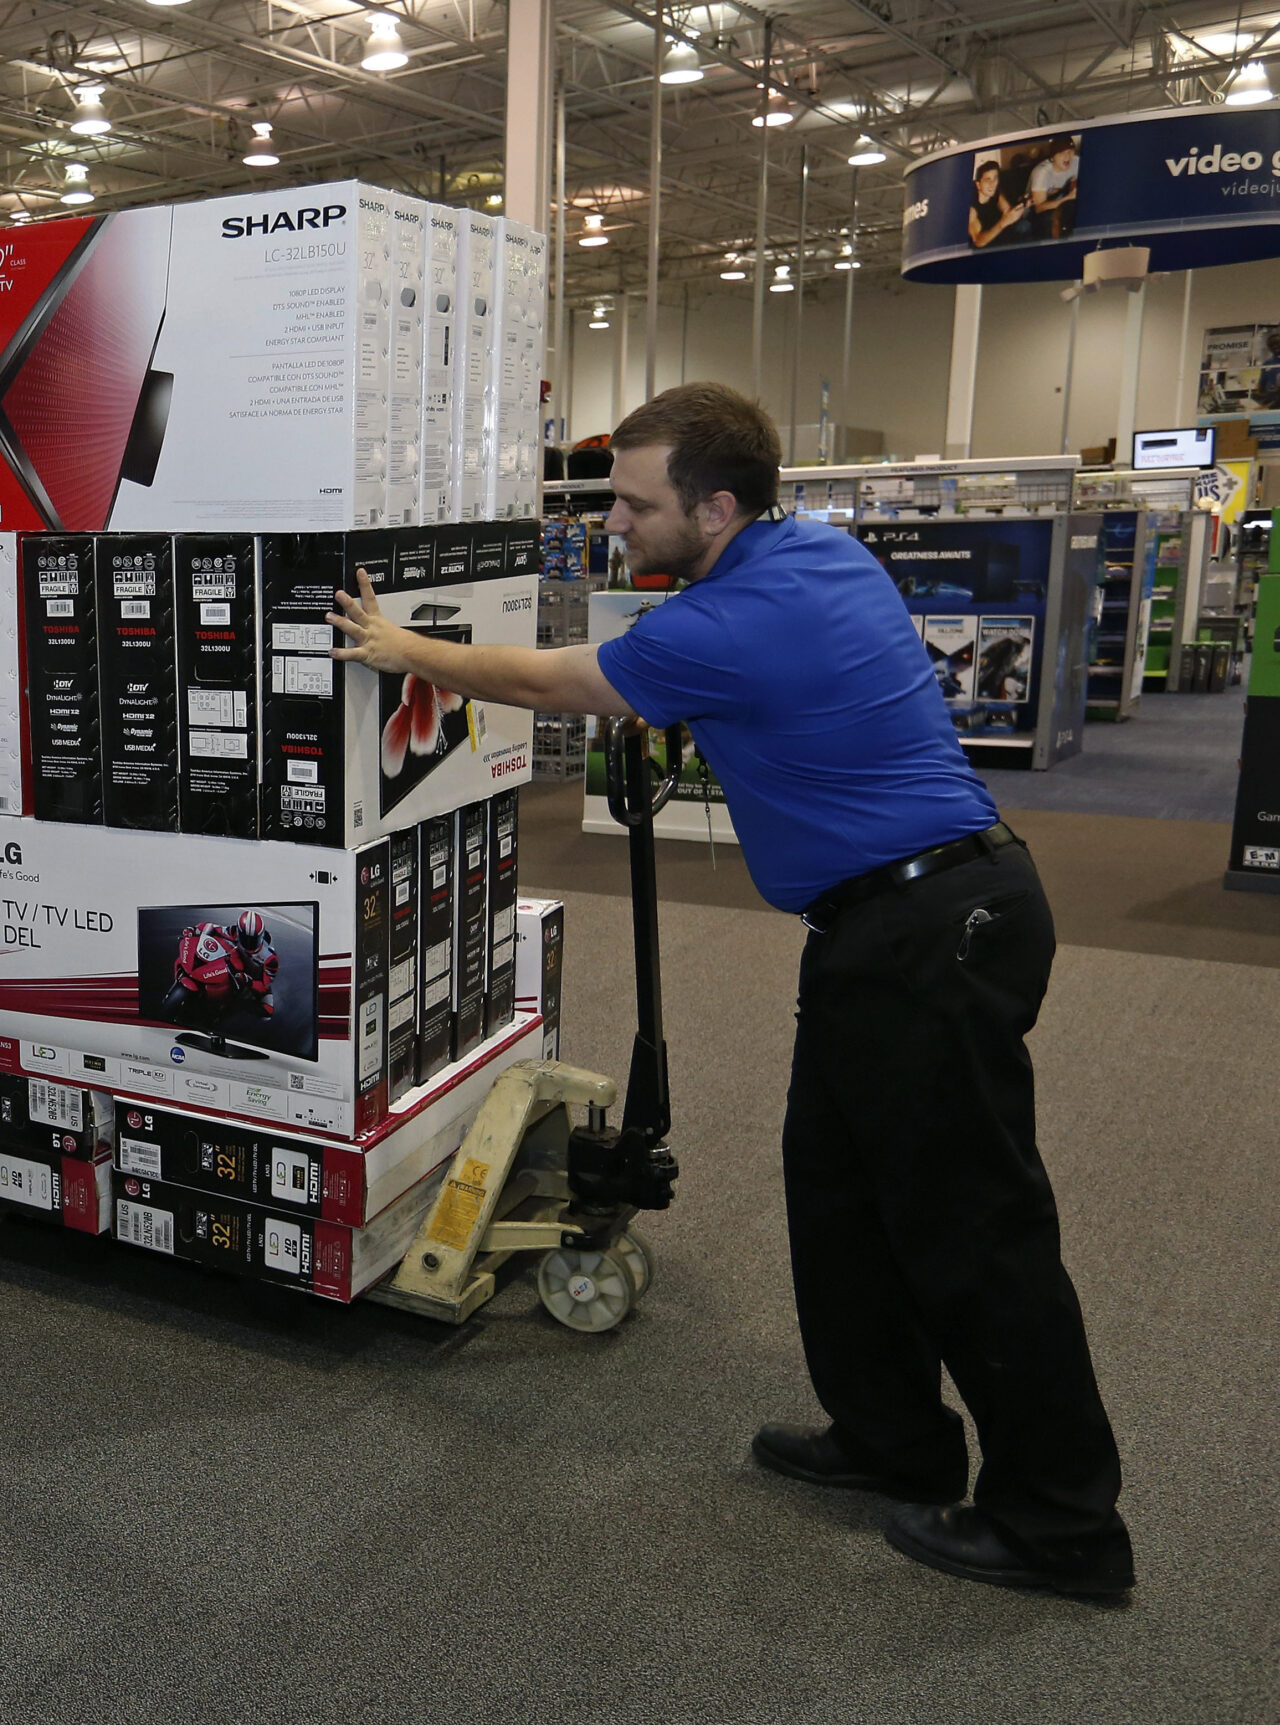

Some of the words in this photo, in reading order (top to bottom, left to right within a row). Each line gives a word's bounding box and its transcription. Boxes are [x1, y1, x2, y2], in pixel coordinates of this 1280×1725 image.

[1165, 144, 1263, 177] video
[359, 199, 385, 213] SHARP
[222, 205, 347, 239] SHARP
[394, 210, 419, 224] SHARP
[431, 218, 454, 231] SHARP
[470, 223, 490, 237] SHARP
[505, 233, 526, 247] SHARP
[264, 242, 347, 263] LC-32LB150U
[0, 280, 14, 292] TV
[289, 289, 307, 297] 1080P
[307, 288, 319, 296] LED
[320, 286, 345, 295] DISPLAY
[316, 298, 345, 308] ENABLED
[316, 311, 345, 319] ENABLED
[289, 325, 306, 333] HDMI
[325, 322, 344, 331] INPUT
[265, 338, 290, 347] ENERGY
[290, 336, 306, 345] STAR
[307, 334, 344, 344] COMPLIANT
[1207, 340, 1249, 351] PROMISE
[272, 361, 304, 370] PANTALLA
[304, 360, 316, 368] LED
[248, 374, 285, 383] COMPATIBLE
[286, 373, 301, 381] CON
[270, 385, 307, 393] COMPATIBLE
[308, 384, 323, 392] CON
[291, 396, 321, 404] ENTRADA
[229, 410, 259, 418] SATISFACE
[269, 408, 293, 417] NORMA
[302, 407, 326, 415] ENERGY
[327, 406, 343, 414] STAR
[883, 531, 920, 542] PS4
[41, 585, 67, 593] FRAGILE
[194, 588, 223, 596] FRAGILE
[43, 625, 80, 634] TOSHIBA
[116, 627, 157, 636] TOSHIBA
[195, 631, 236, 640] TOSHIBA
[281, 744, 324, 756] TOSHIBA
[491, 754, 527, 779] TOSHIBA
[15, 871, 40, 883] Good
[370, 863, 380, 879] LG
[2, 900, 28, 921] TV
[42, 905, 68, 926] TV
[74, 909, 113, 932] LED
[4, 927, 41, 949] DEL
[198, 947, 210, 959] LG
[32, 1045, 56, 1060] LED
[127, 1067, 151, 1077] TRIPLE
[246, 1088, 271, 1100] Energy
[145, 1115, 154, 1131] LG
[52, 1133, 61, 1148] LG
[215, 1145, 236, 1181] 32"
[309, 1161, 320, 1203] HDMI
[142, 1183, 151, 1199] LG
[301, 1233, 311, 1274] HDMI
